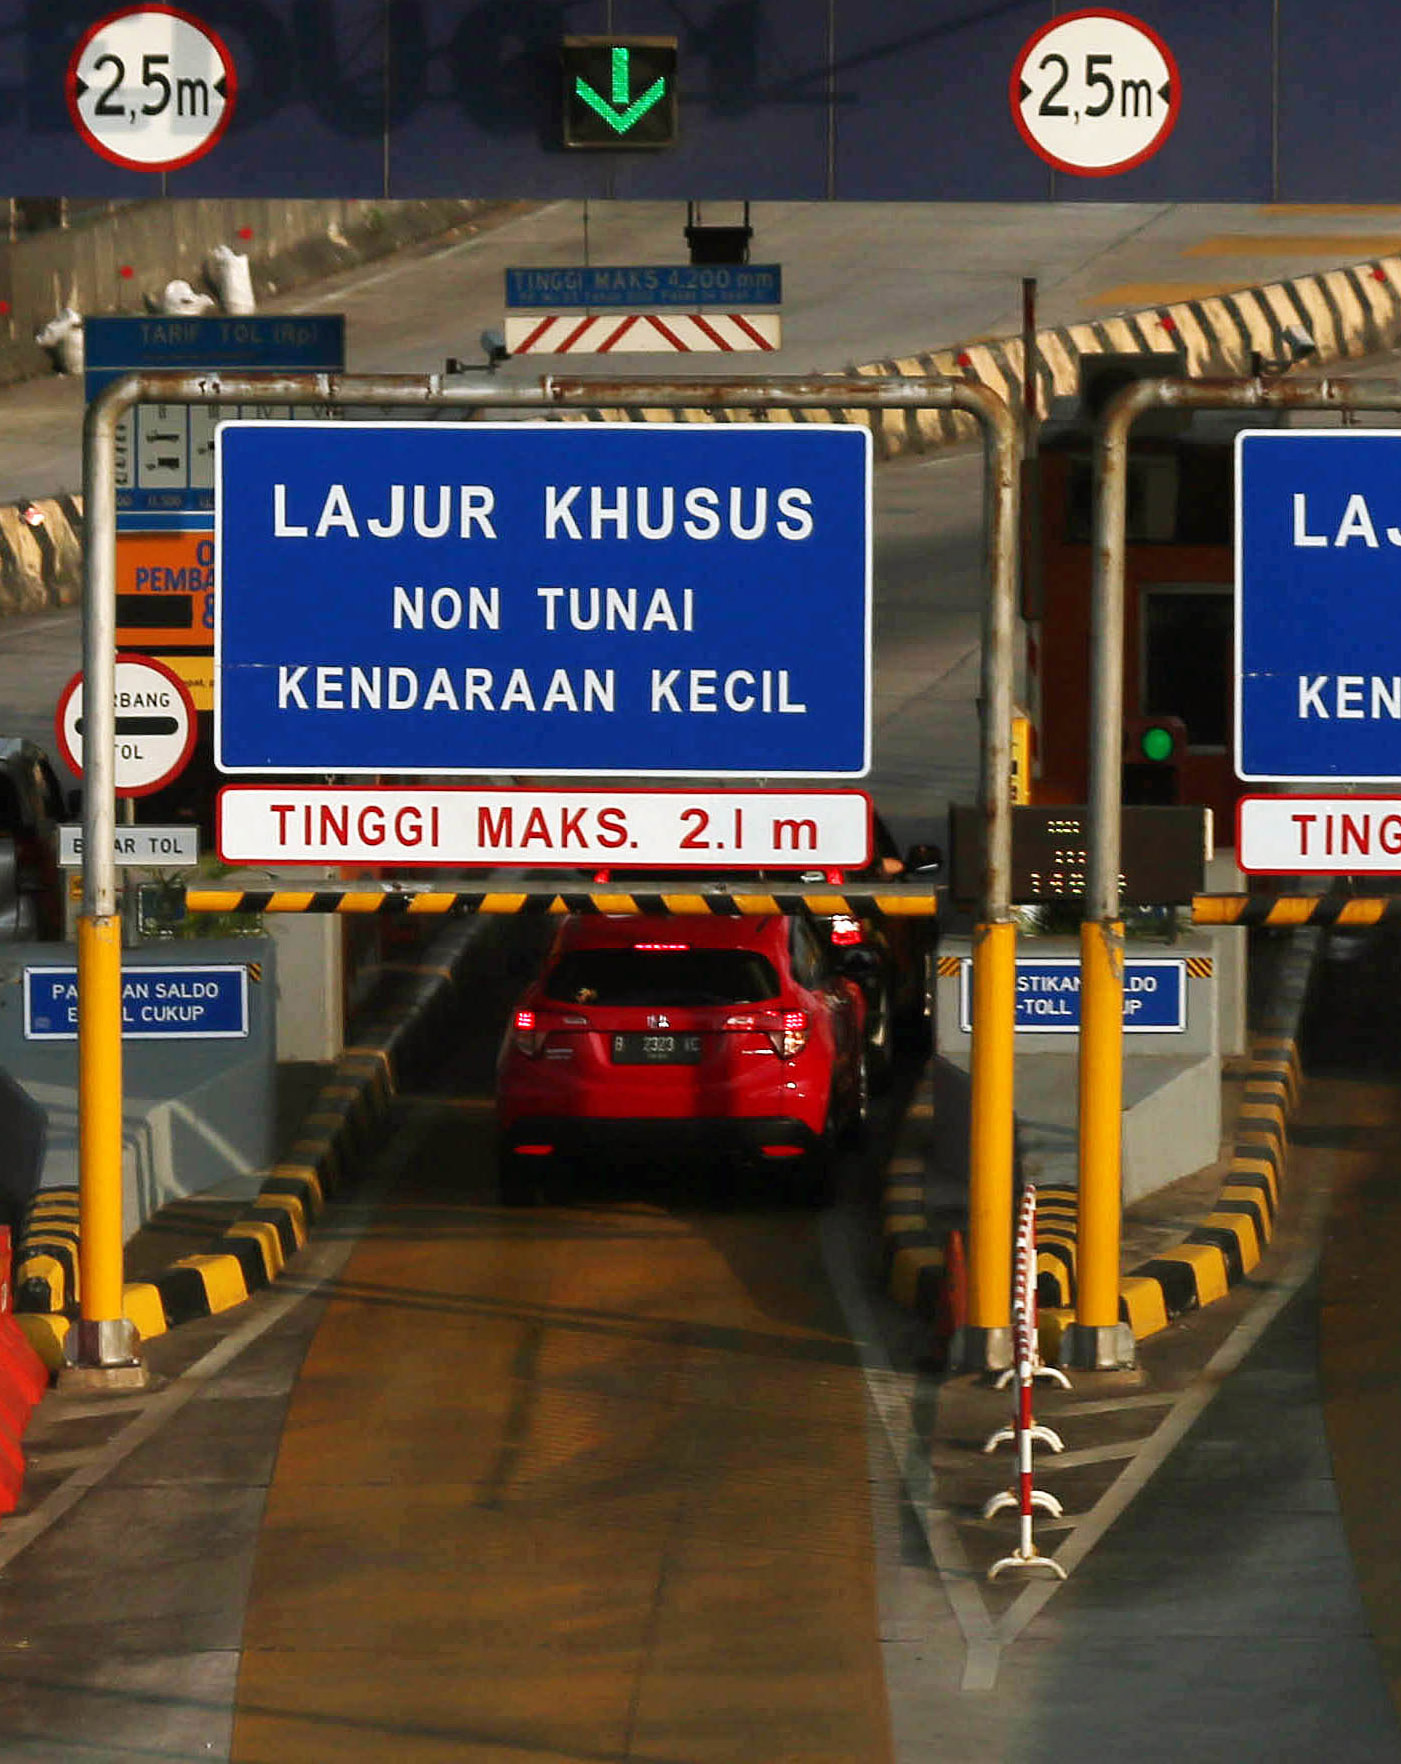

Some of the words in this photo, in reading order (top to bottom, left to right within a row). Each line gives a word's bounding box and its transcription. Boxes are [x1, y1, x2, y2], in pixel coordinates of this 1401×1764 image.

[94, 54, 208, 124] 2,5m
[1038, 53, 1152, 124] 2,5m
[513, 270, 583, 291] TINGGI
[594, 269, 659, 289] MAKS
[668, 269, 731, 289] 4.200
[141, 323, 197, 345] TARIF
[219, 323, 263, 343] TOL
[274, 484, 497, 539] LAJUR
[545, 486, 814, 540] KHUSUS
[393, 586, 499, 630] NON
[537, 587, 694, 631] TUNAI
[278, 667, 614, 712] KENDARAAN
[651, 669, 807, 713] KECIL
[150, 838, 183, 854] TOL
[271, 804, 439, 847] TINGGI
[478, 806, 638, 849] MAKS.
[773, 819, 818, 850] m
[141, 1005, 204, 1021] CUKUP
[155, 983, 219, 998] SALDO
